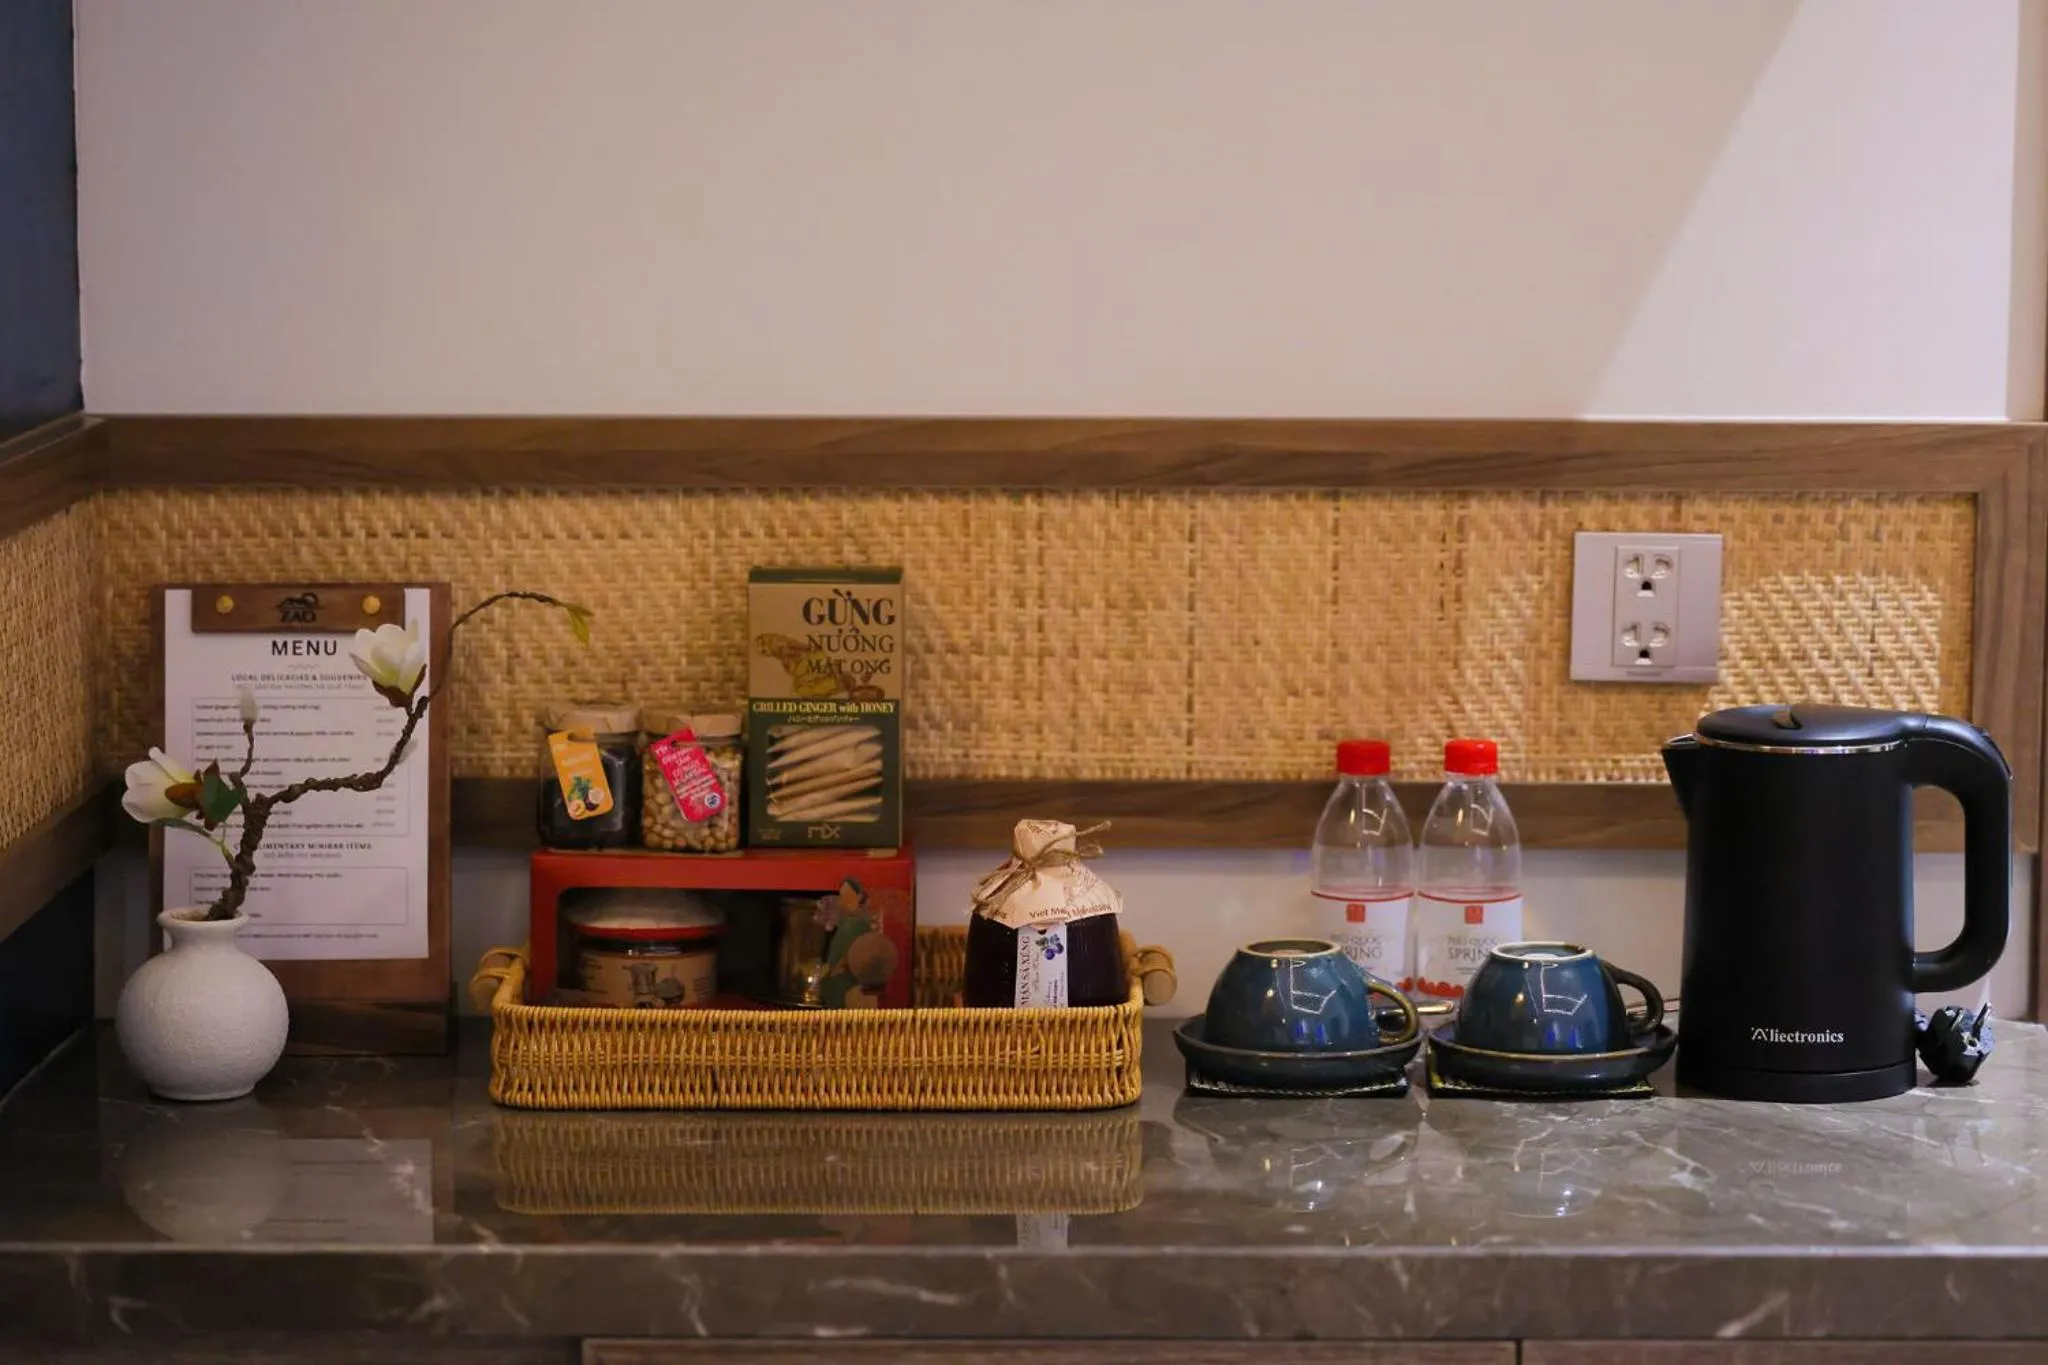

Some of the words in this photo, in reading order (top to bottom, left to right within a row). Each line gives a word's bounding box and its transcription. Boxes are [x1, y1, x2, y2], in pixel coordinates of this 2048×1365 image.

[271, 640, 338, 656] MENU
[850, 657, 892, 675] ONG
[231, 674, 258, 682] LOCAL
[260, 674, 309, 682] DELICACIES
[752, 702, 797, 713] GRILLED
[799, 702, 838, 713] GINGER
[839, 702, 859, 713] with
[860, 702, 895, 713] HONEY
